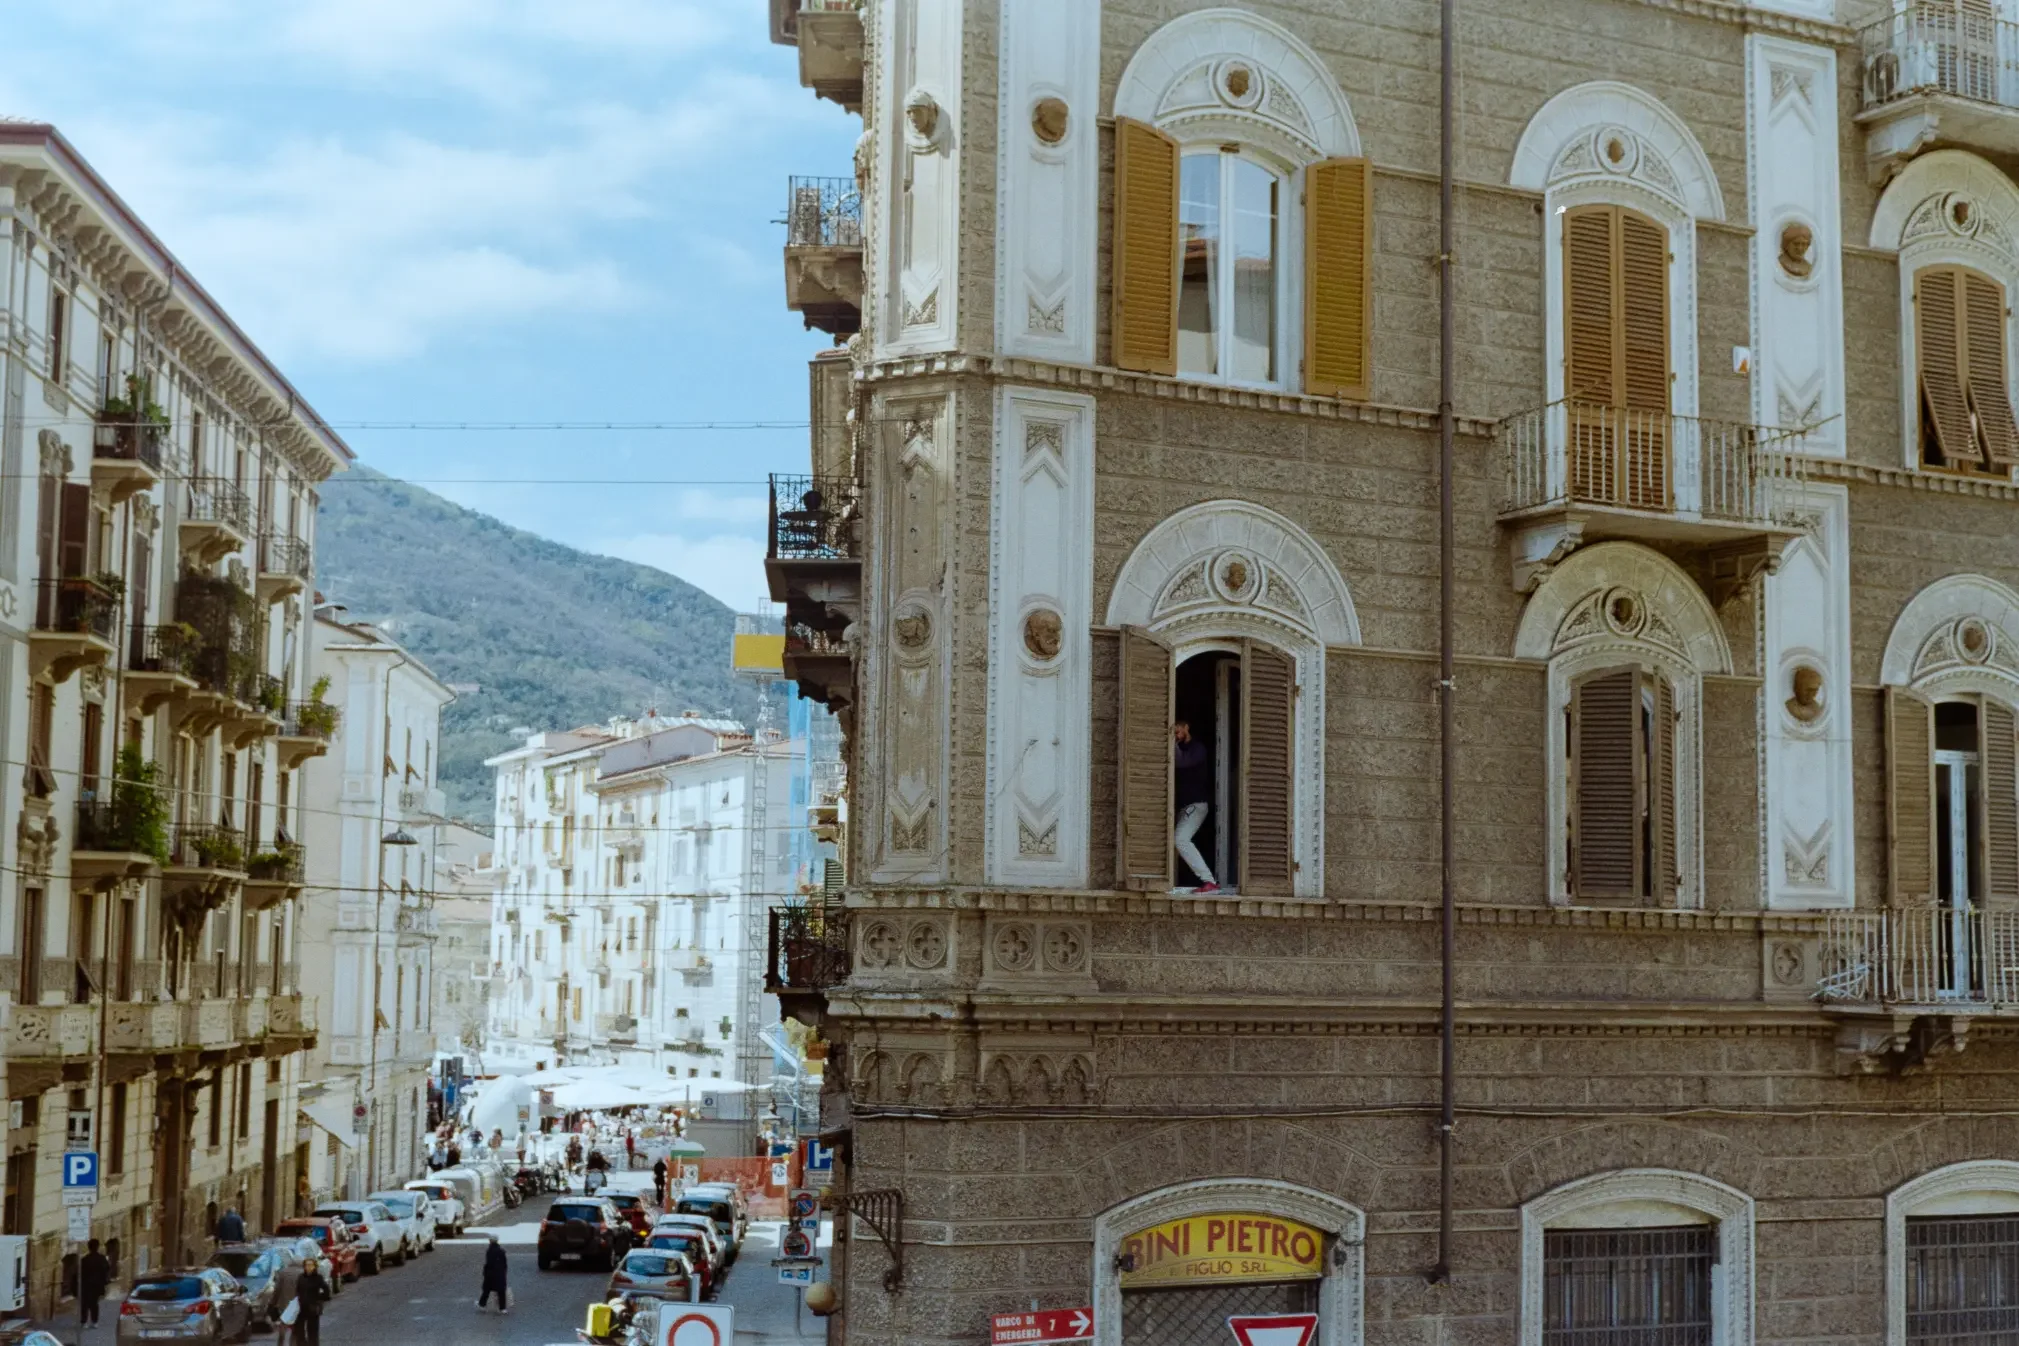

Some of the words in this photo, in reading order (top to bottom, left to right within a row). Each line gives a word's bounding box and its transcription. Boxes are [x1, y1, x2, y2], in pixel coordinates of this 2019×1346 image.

[70, 1156, 92, 1184] P
[1126, 1222, 1190, 1271] BINI
[1207, 1219, 1316, 1265] PIETRO
[1186, 1261, 1233, 1277] FIGLIO
[996, 1316, 1021, 1328] VARCO
[1026, 1315, 1035, 1325] DI
[996, 1328, 1042, 1341] EMERGENZA
